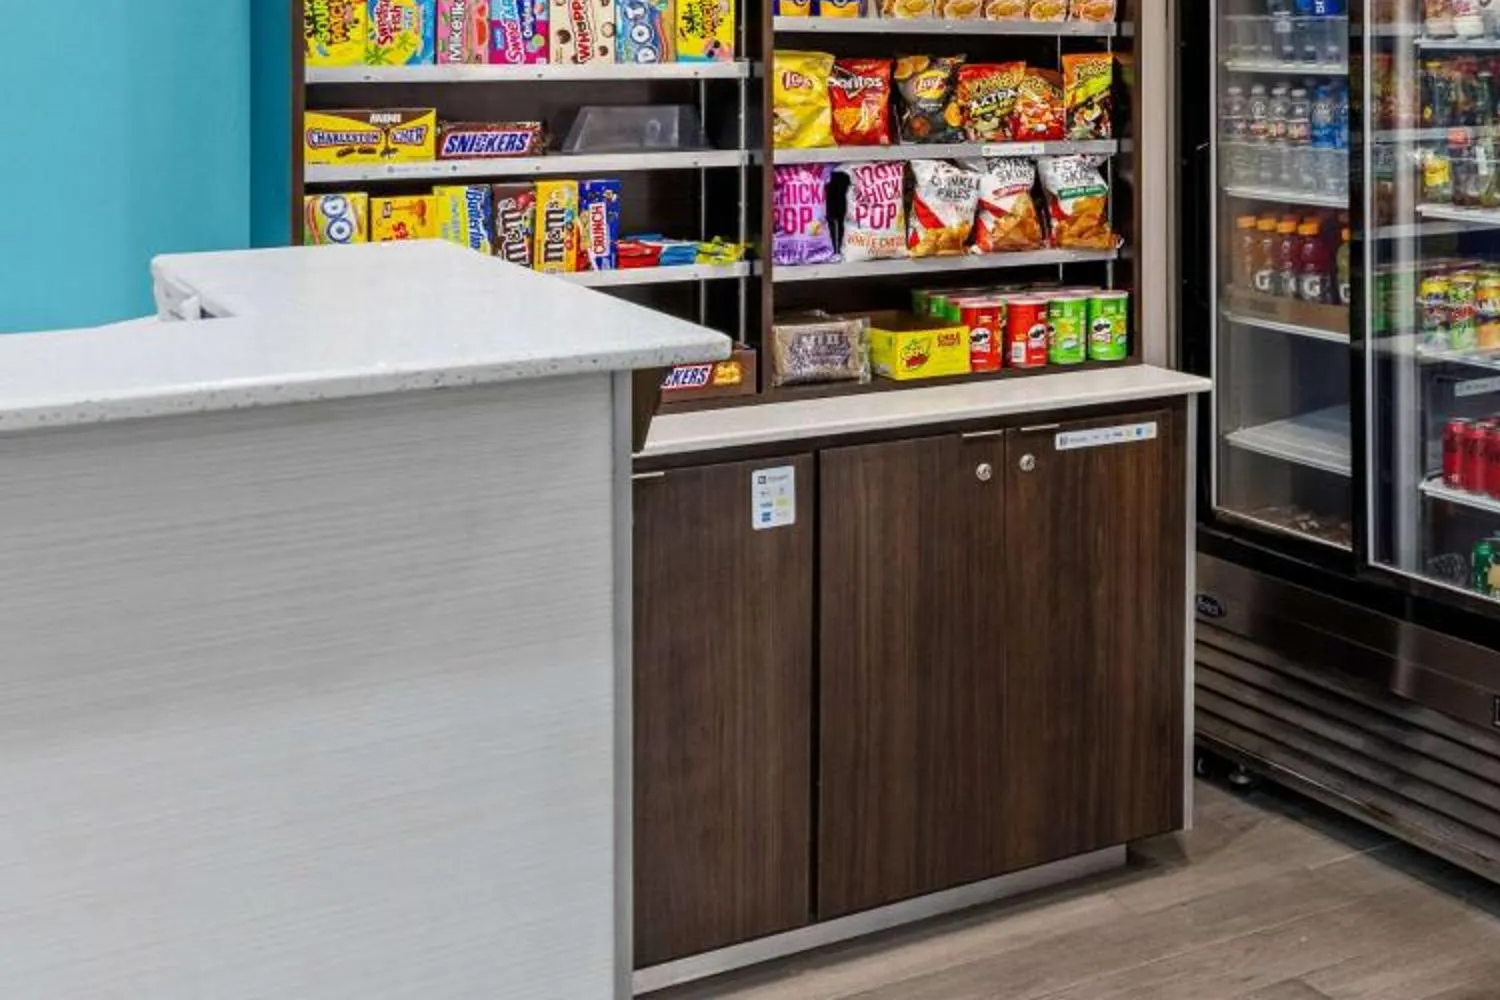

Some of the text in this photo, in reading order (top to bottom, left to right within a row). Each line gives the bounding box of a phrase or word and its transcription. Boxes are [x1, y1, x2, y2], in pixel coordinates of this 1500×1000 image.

[828, 75, 883, 89] Doritos
[444, 133, 530, 154] SNICKERS
[465, 185, 484, 250] Butterfin
[855, 202, 897, 230] POP
[591, 204, 605, 254] CRUNCH
[1303, 275, 1321, 297] G
[665, 367, 708, 385] KERS
